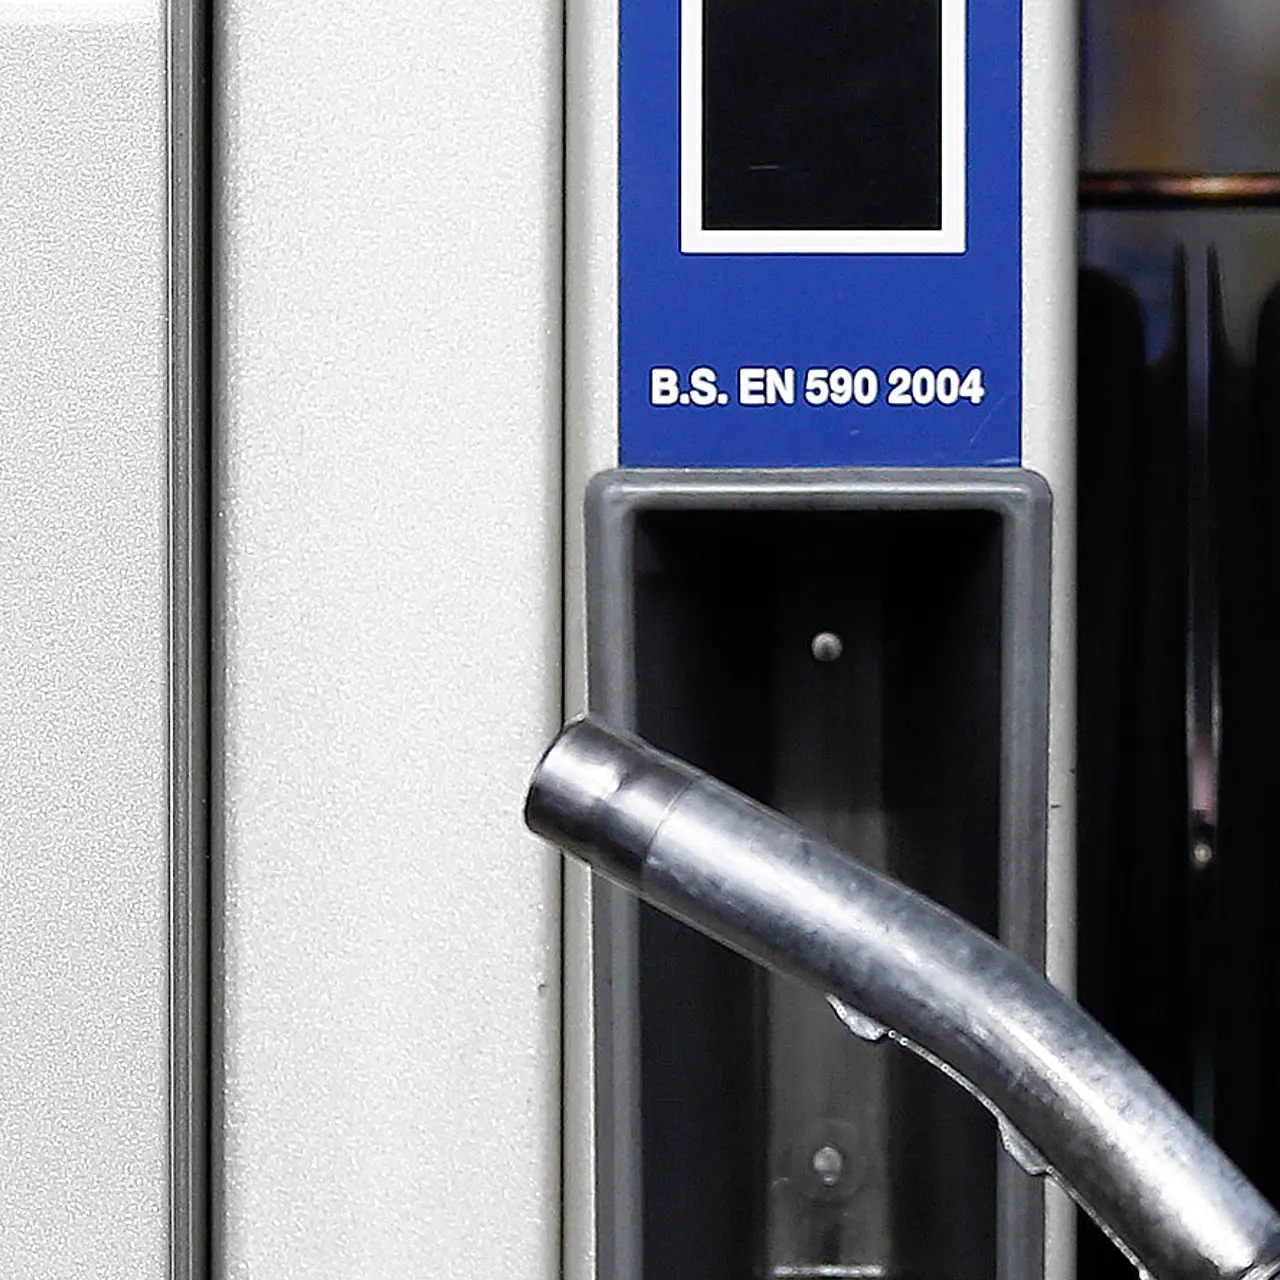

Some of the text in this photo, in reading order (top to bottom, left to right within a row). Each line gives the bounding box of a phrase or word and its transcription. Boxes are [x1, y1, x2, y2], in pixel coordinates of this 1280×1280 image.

[650, 367, 986, 406] B.S. EN 590 2004
